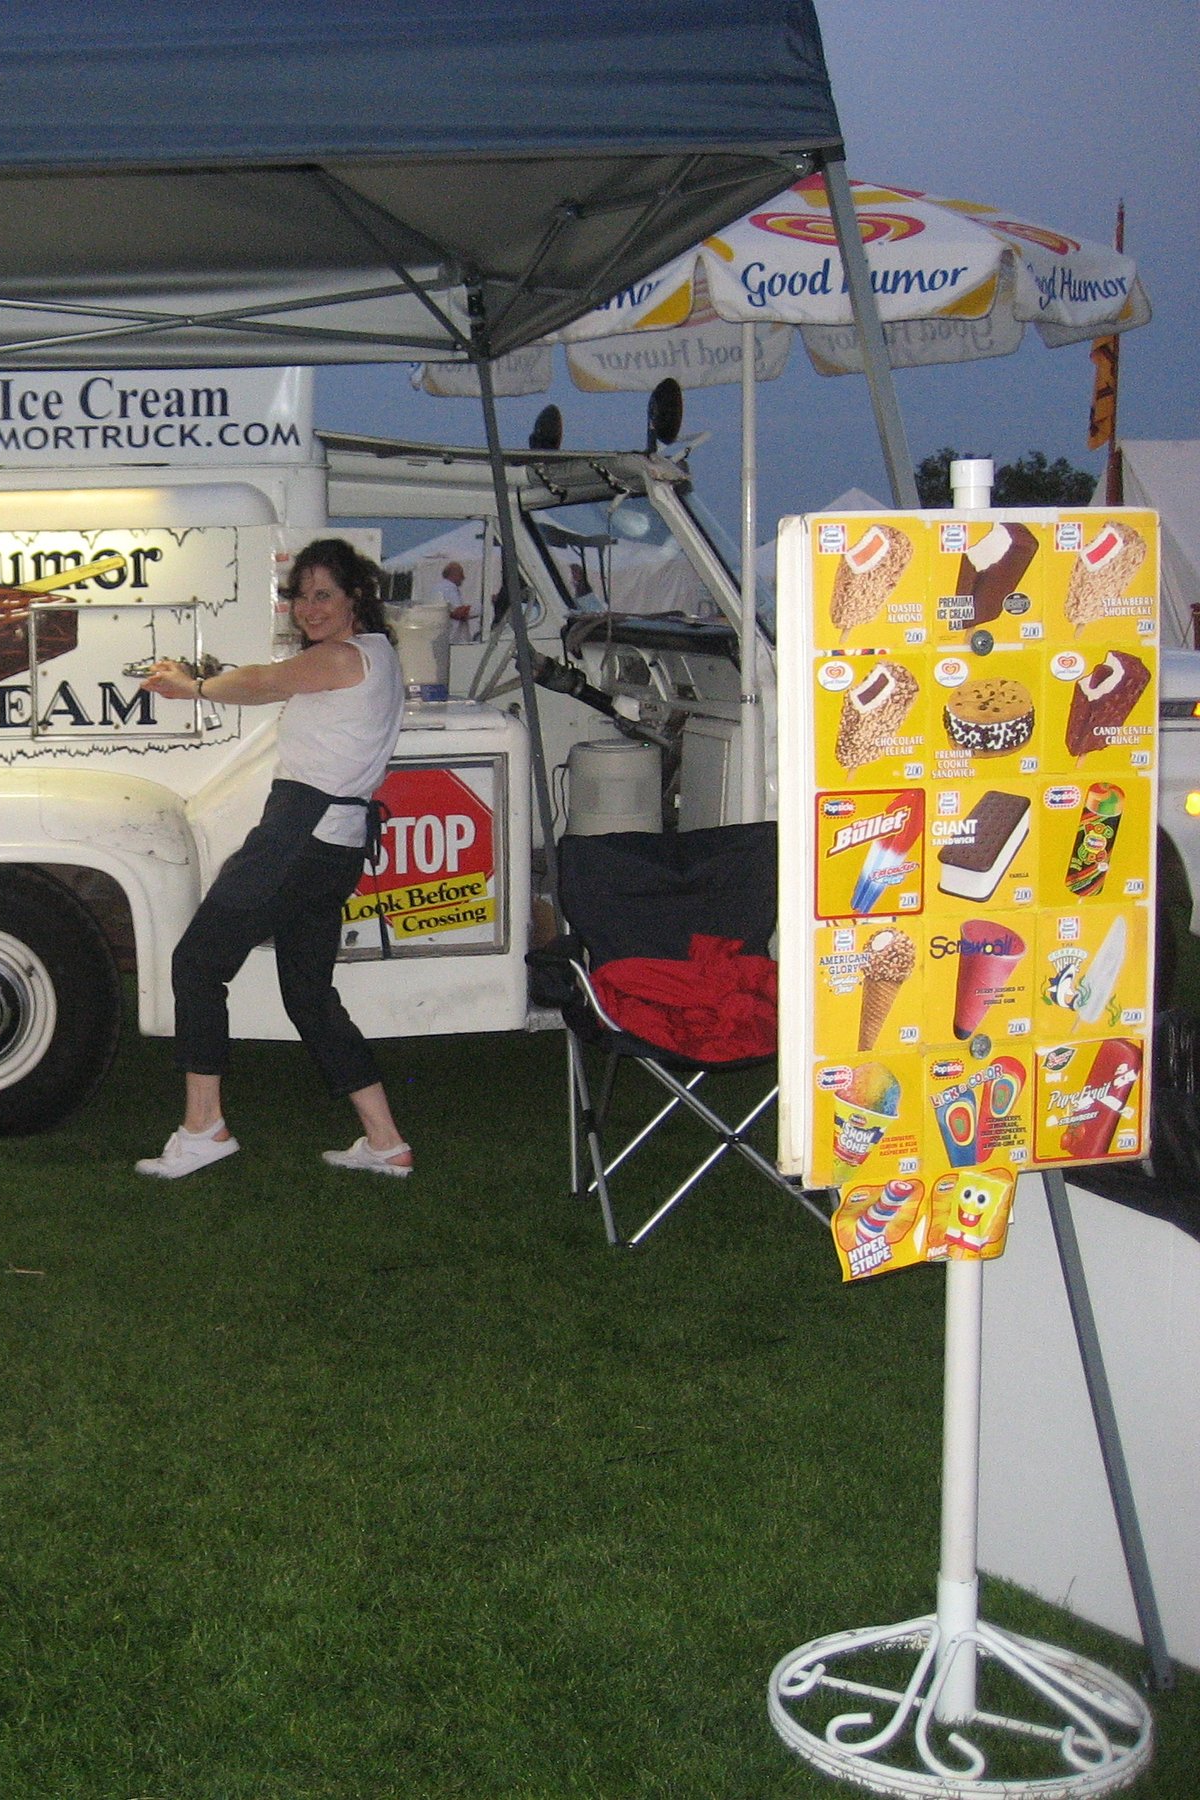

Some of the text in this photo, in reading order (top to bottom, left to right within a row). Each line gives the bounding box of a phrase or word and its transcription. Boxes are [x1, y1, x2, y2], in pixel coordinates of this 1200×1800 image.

[741, 258, 831, 306] Good
[1060, 267, 1127, 302] Humor
[79, 376, 230, 420] Cream
[938, 597, 973, 608] PREMIUM
[1102, 597, 1153, 607] STRAWBERRY
[886, 603, 922, 613] TOASTED
[1104, 607, 1152, 617] SHORTCAKE
[887, 613, 922, 623] ALMOND
[937, 609, 975, 619] ICE CREAM
[948, 620, 963, 631] BAR
[1093, 726, 1154, 736] CANDY CENTER
[874, 736, 925, 747] CHOCOLATE
[1105, 735, 1141, 745] CRUNCH
[885, 746, 914, 756] ECLAIR
[934, 749, 972, 760] PREMIUM
[937, 759, 969, 769] COOKIE
[931, 768, 976, 779] SANDWICH
[828, 810, 908, 855] Bullet
[931, 819, 979, 836] GIANT
[931, 836, 976, 846] SANDWICH
[344, 881, 482, 922] Look Before
[402, 905, 487, 932] Crossing
[929, 934, 1012, 959] Screwball
[819, 953, 871, 966] AMERICAN
[1051, 956, 1083, 973] WHITE
[828, 965, 858, 975] GLORY
[930, 1088, 960, 1108] LICK
[968, 1064, 1003, 1088] COLOR
[848, 1235, 886, 1264] HYPER
[851, 1246, 892, 1278] STRIPE
